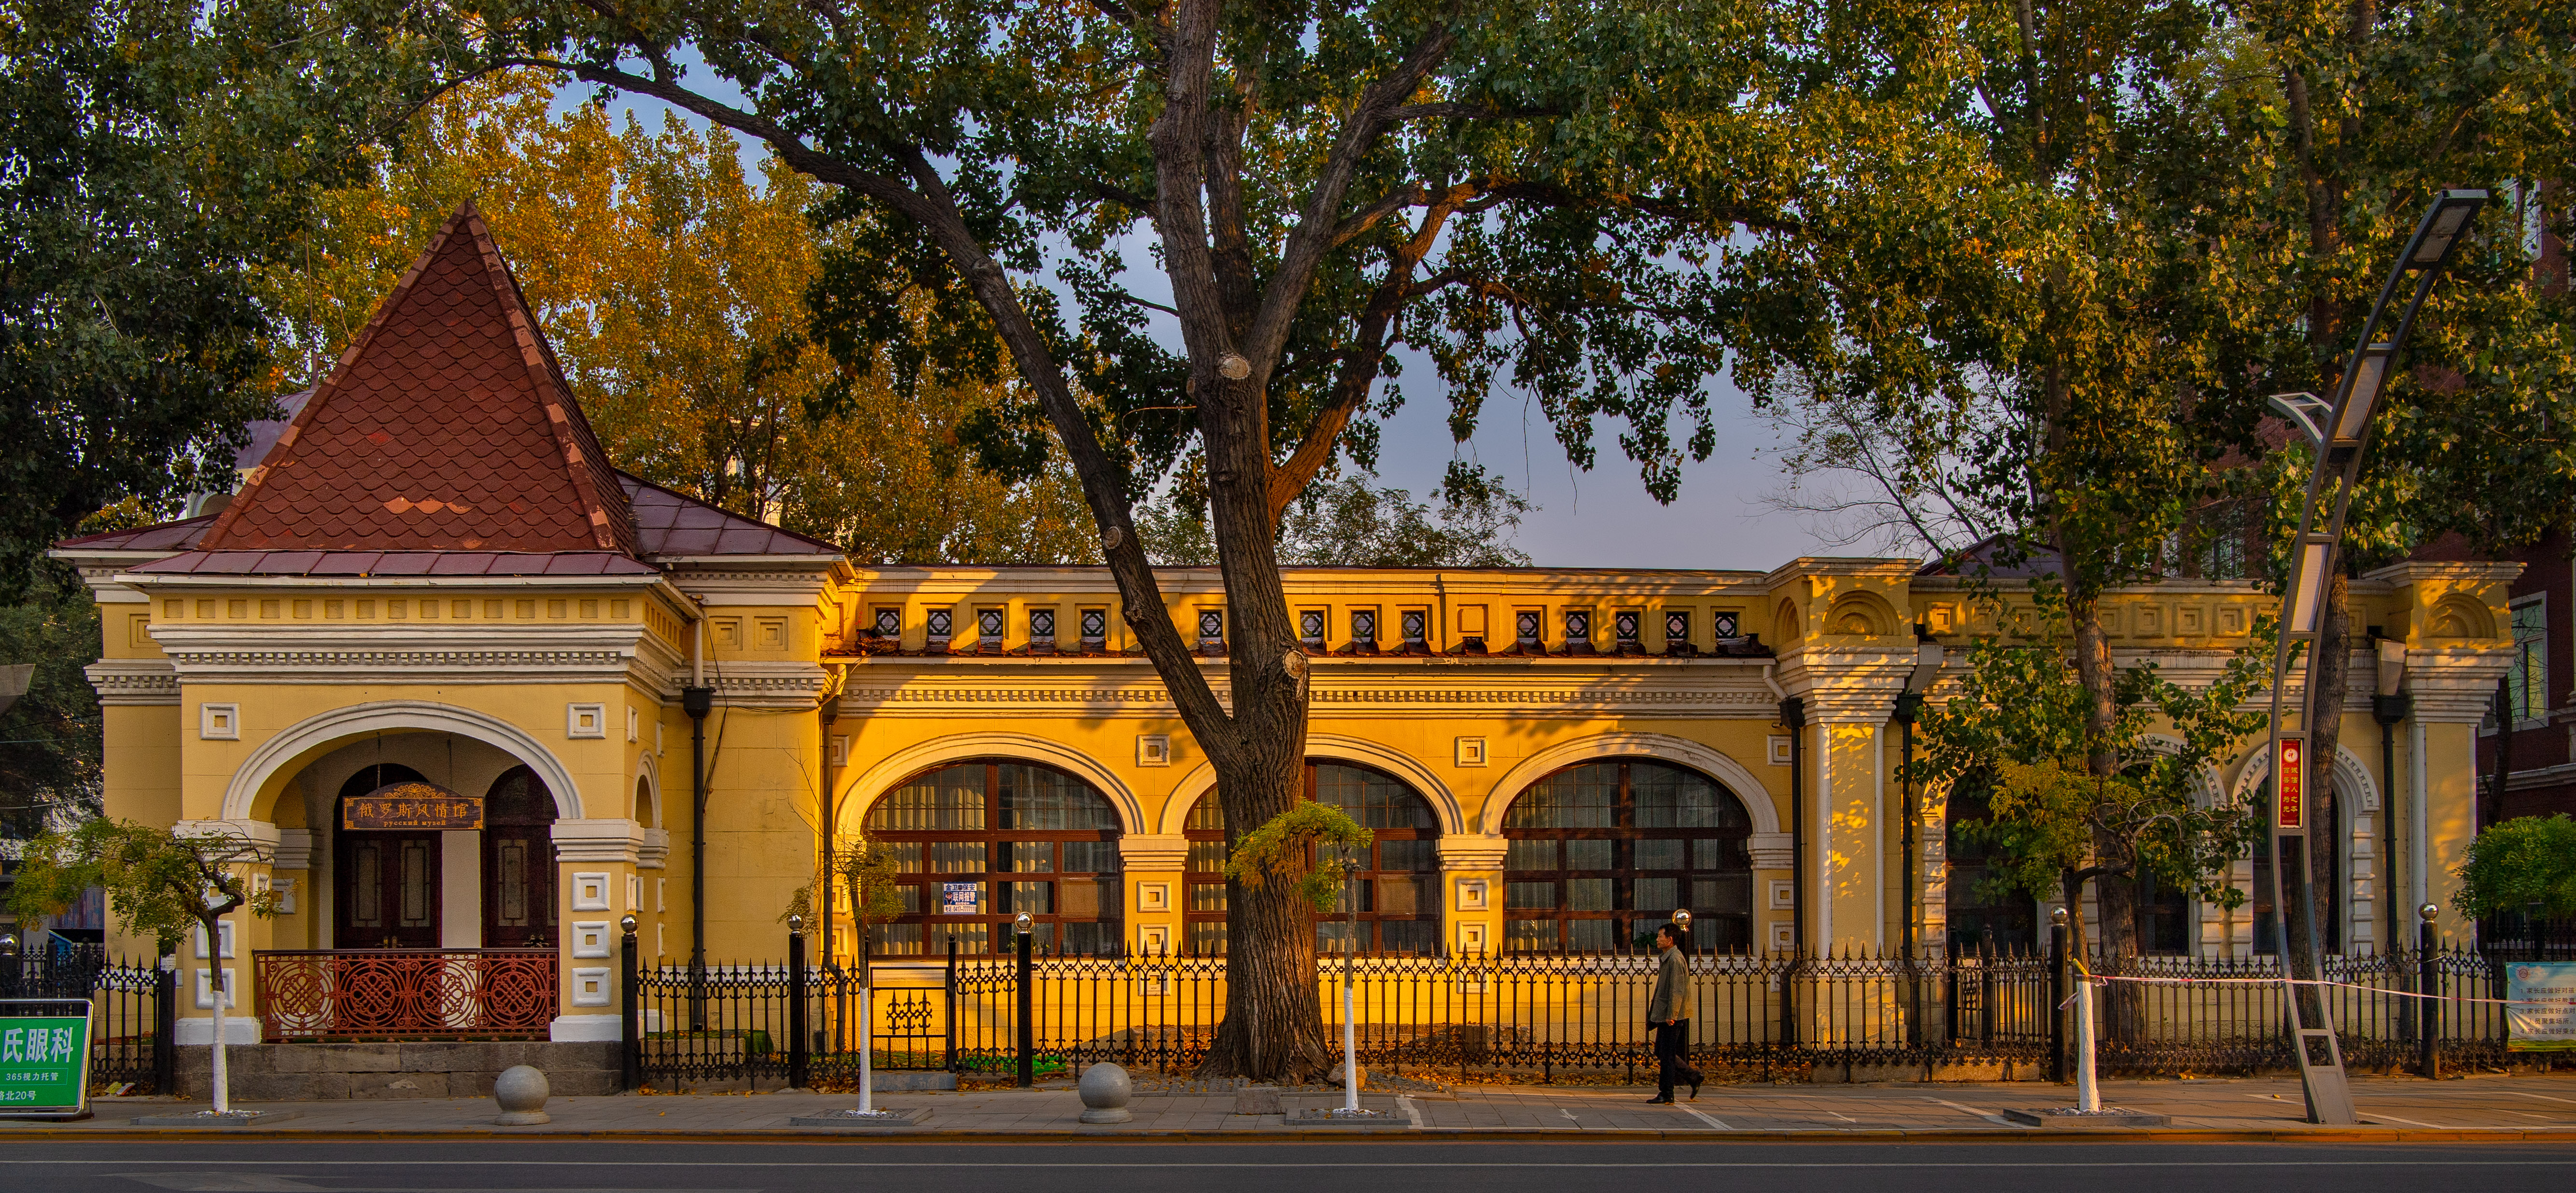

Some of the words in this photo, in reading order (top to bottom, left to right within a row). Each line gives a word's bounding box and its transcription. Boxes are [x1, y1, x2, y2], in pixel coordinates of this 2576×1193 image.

[359, 802, 468, 818] 俄罗斯风情馆
[953, 892, 975, 902] 联网报警
[2, 1027, 73, 1063] 氏眼科
[6, 1072, 58, 1081] 365视力托管
